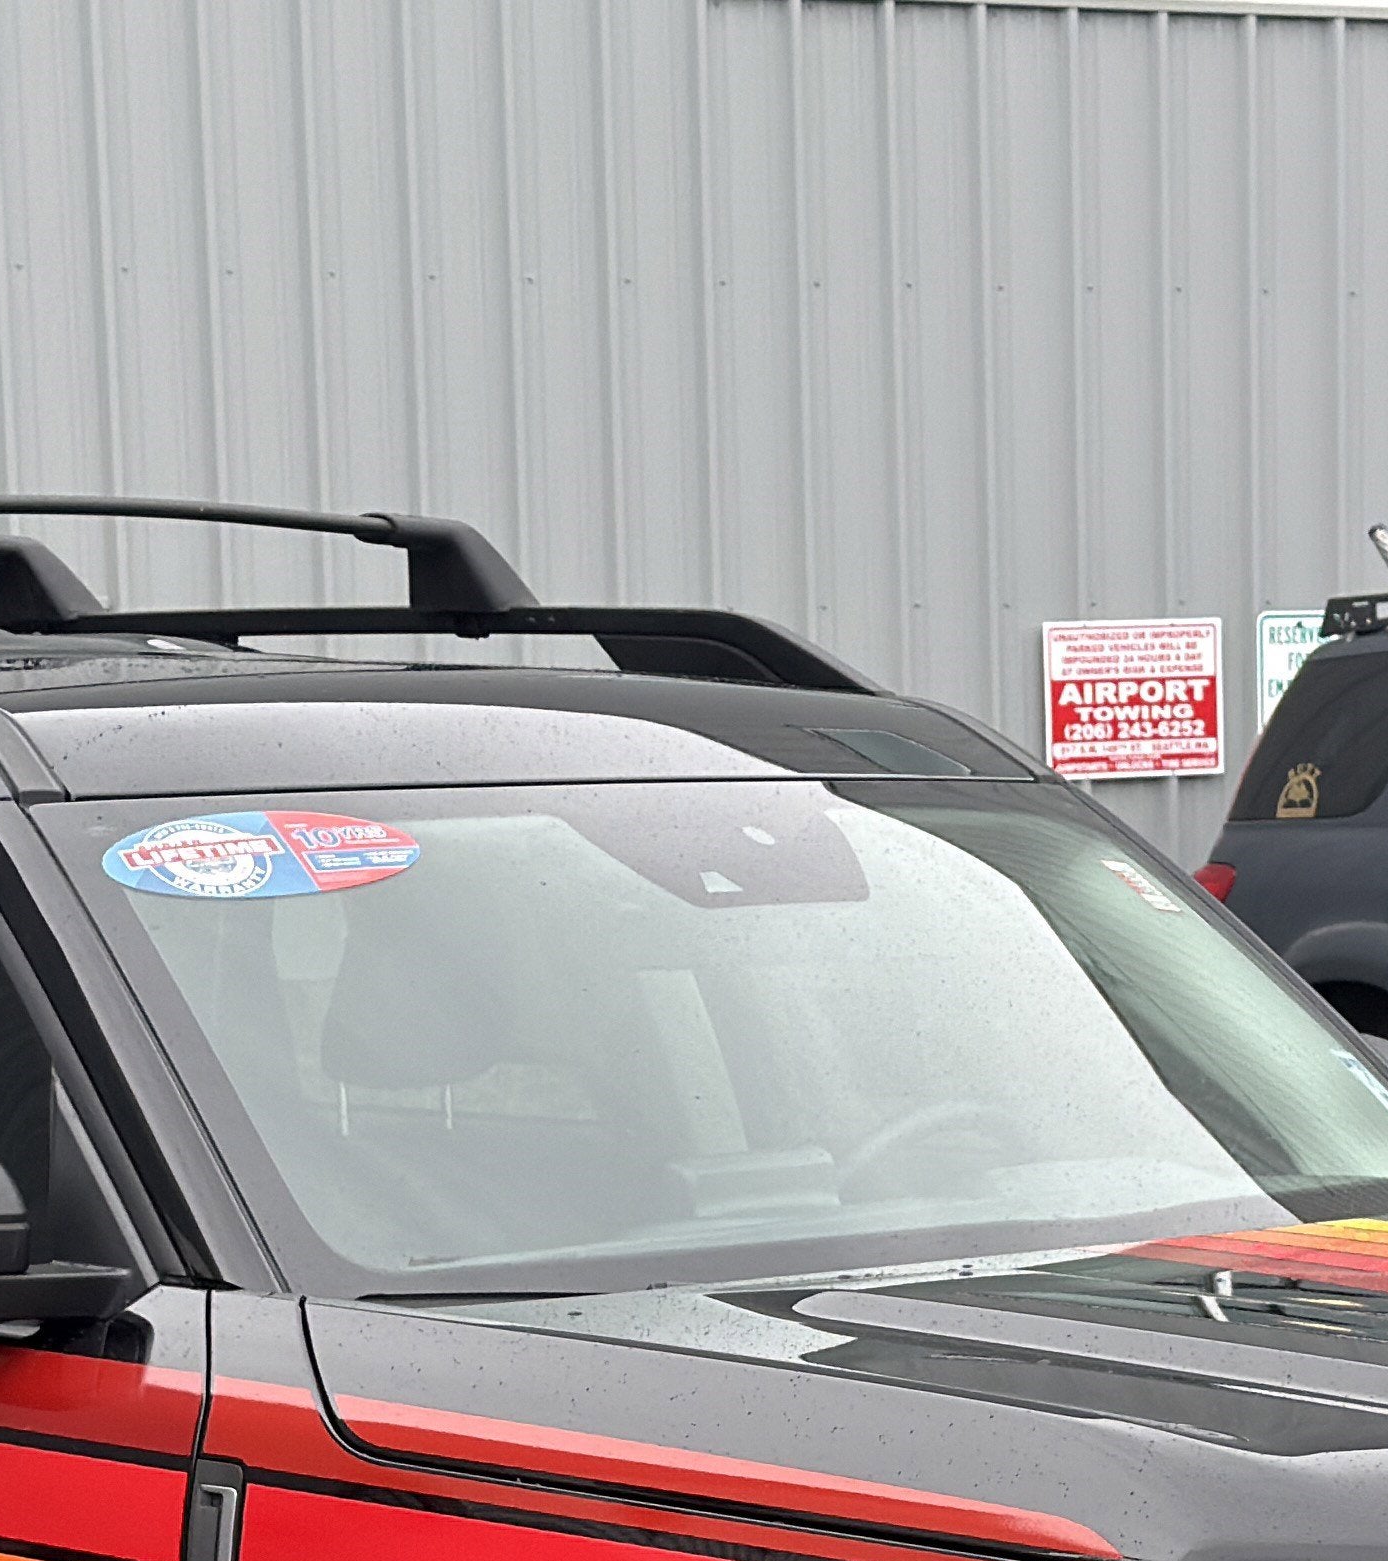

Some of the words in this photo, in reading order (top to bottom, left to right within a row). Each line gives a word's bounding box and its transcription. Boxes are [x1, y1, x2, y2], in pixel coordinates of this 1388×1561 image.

[1058, 679, 1211, 705] AIRPORT
[1074, 703, 1194, 722] TOWING
[1063, 722, 1113, 741] (206)
[1117, 719, 1205, 739] 243-6252
[131, 838, 273, 866] LIFETIME
[174, 865, 266, 895] WARRANTY
